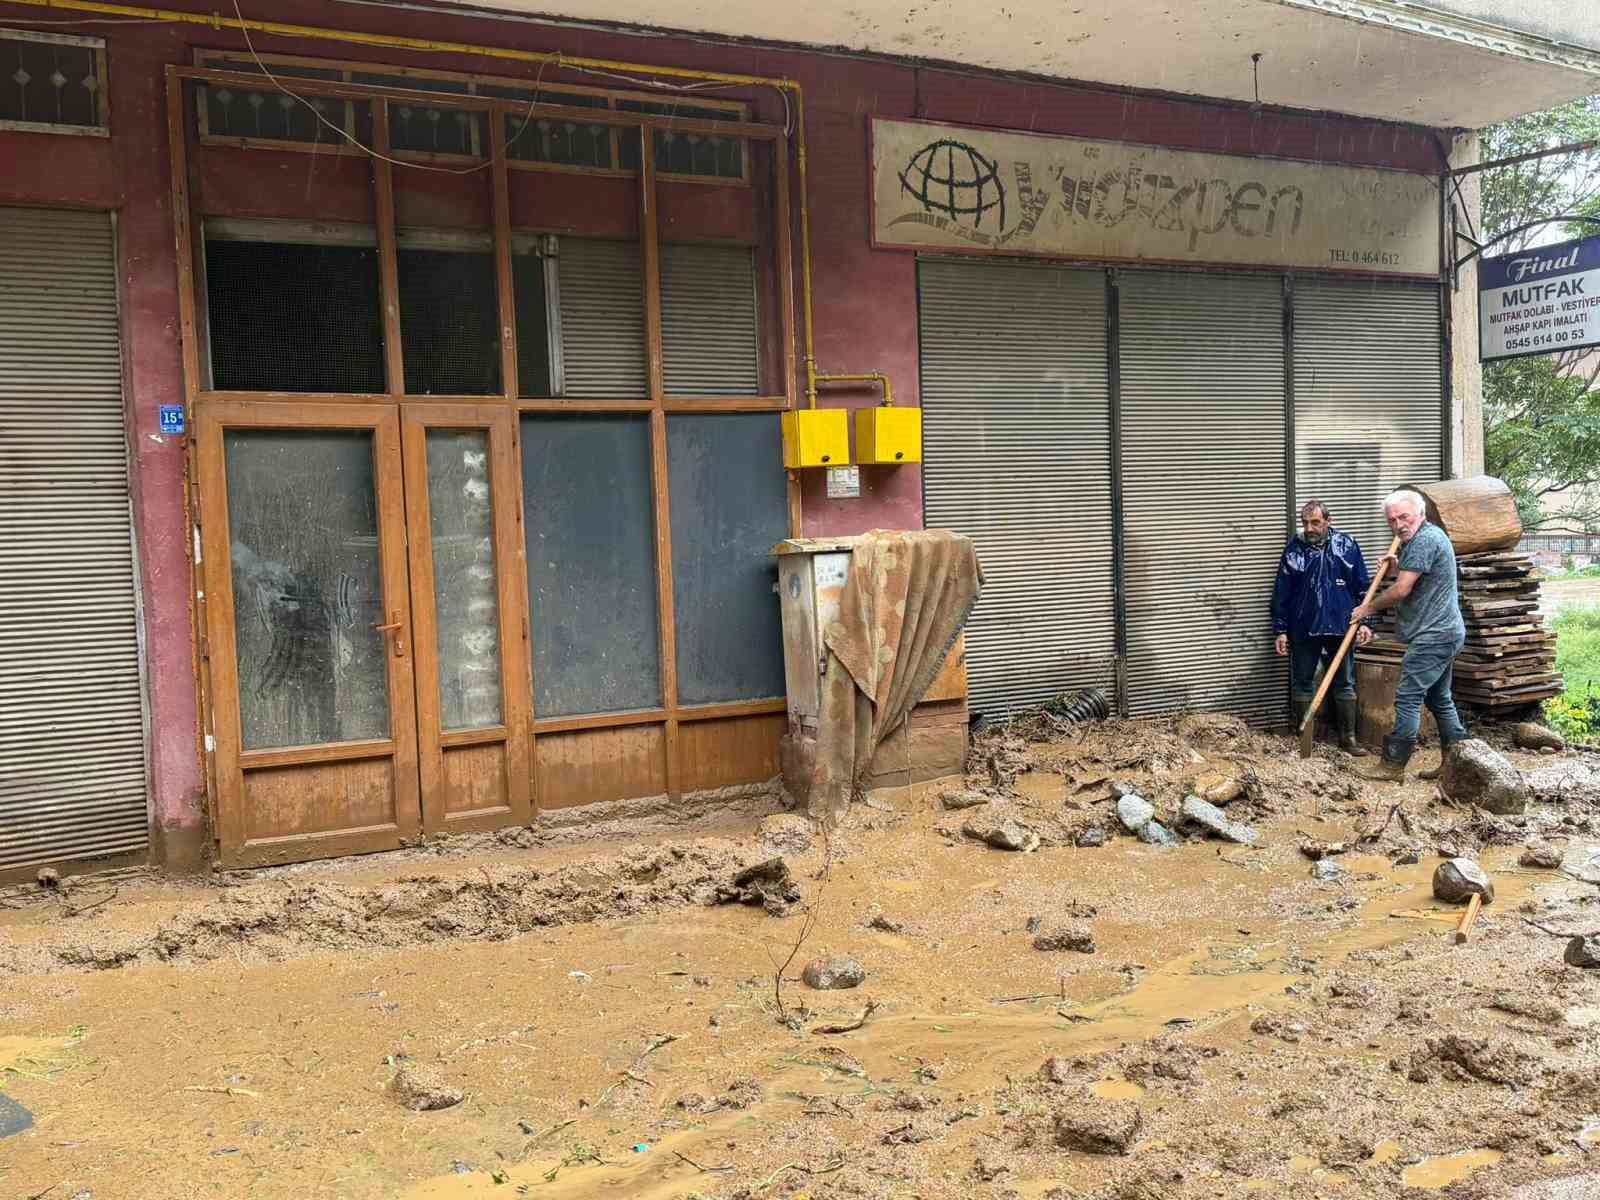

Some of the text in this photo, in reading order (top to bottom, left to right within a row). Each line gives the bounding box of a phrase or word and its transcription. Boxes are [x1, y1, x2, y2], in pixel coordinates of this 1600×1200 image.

[1506, 247, 1580, 282] Final
[1502, 277, 1585, 308] MUTFAK
[1489, 311, 1521, 324] MUTFAK
[1523, 304, 1554, 319] DOLABI
[1504, 322, 1531, 336] AHŞAP
[1532, 319, 1552, 331] KAPI
[1505, 329, 1584, 350] 0545 614 00 53
[163, 412, 178, 424] 15
